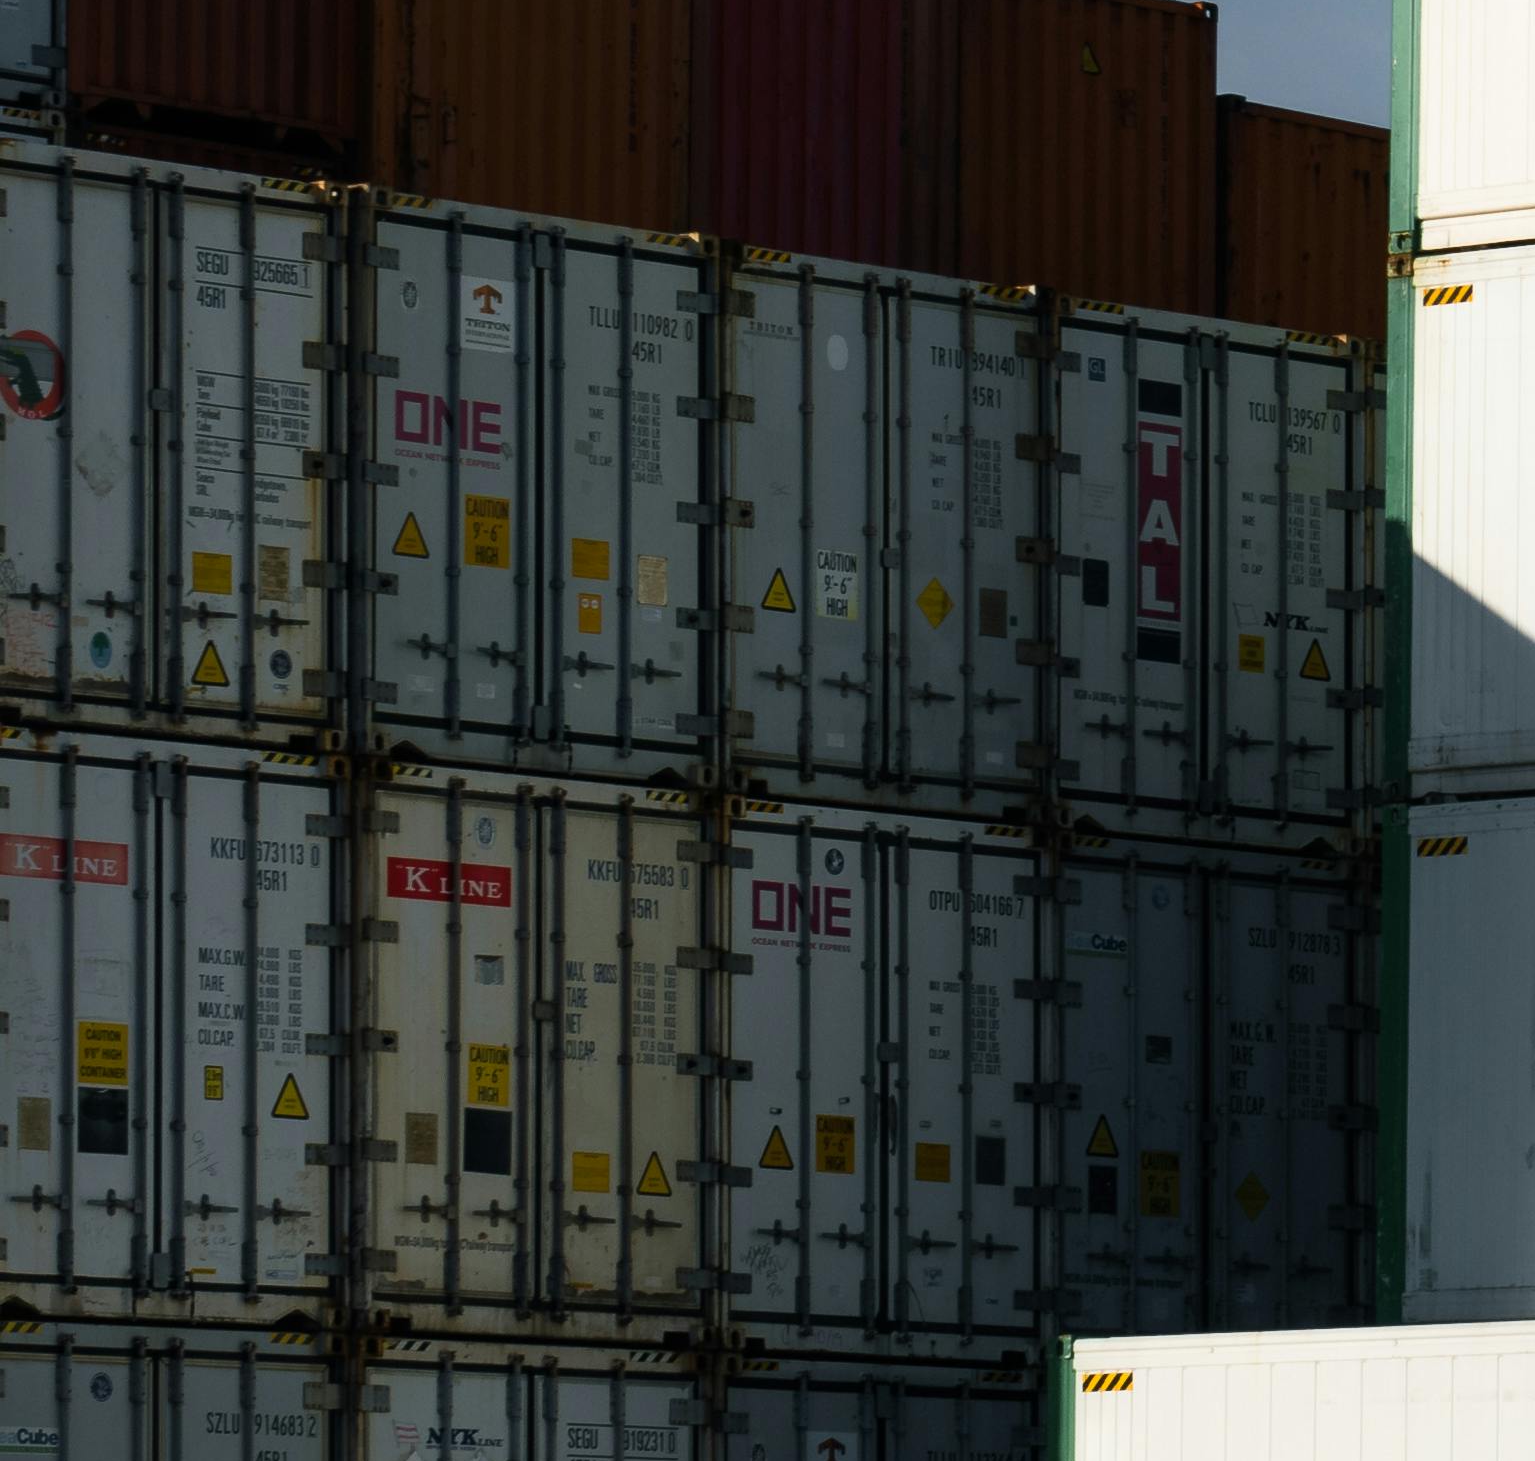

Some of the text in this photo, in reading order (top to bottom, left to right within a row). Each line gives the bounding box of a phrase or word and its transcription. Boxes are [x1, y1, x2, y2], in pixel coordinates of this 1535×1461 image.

[196, 252, 309, 287] SEGU 925665 1
[196, 287, 226, 309] 45R1
[466, 318, 510, 331] TRITON
[589, 306, 693, 339] TLLU 110982 0
[632, 341, 662, 363] 45R1
[395, 390, 501, 454] ONE
[466, 497, 509, 518] CAUTION
[1140, 430, 1179, 613] TAL
[475, 546, 498, 564] HIGH
[818, 552, 857, 573] CAUTION
[827, 598, 848, 617] HIGH
[211, 837, 244, 860] KKFU
[311, 846, 319, 866] 0
[440, 878, 502, 899] LINE
[752, 880, 851, 937] ONE
[930, 891, 960, 912] OTPU
[1017, 898, 1024, 915] 7
[206, 1413, 317, 1437] SZLU 914683 2
[427, 1427, 503, 1447] NYK LINE
[568, 1428, 599, 1448] SEGU
[668, 1433, 675, 1453] 0
